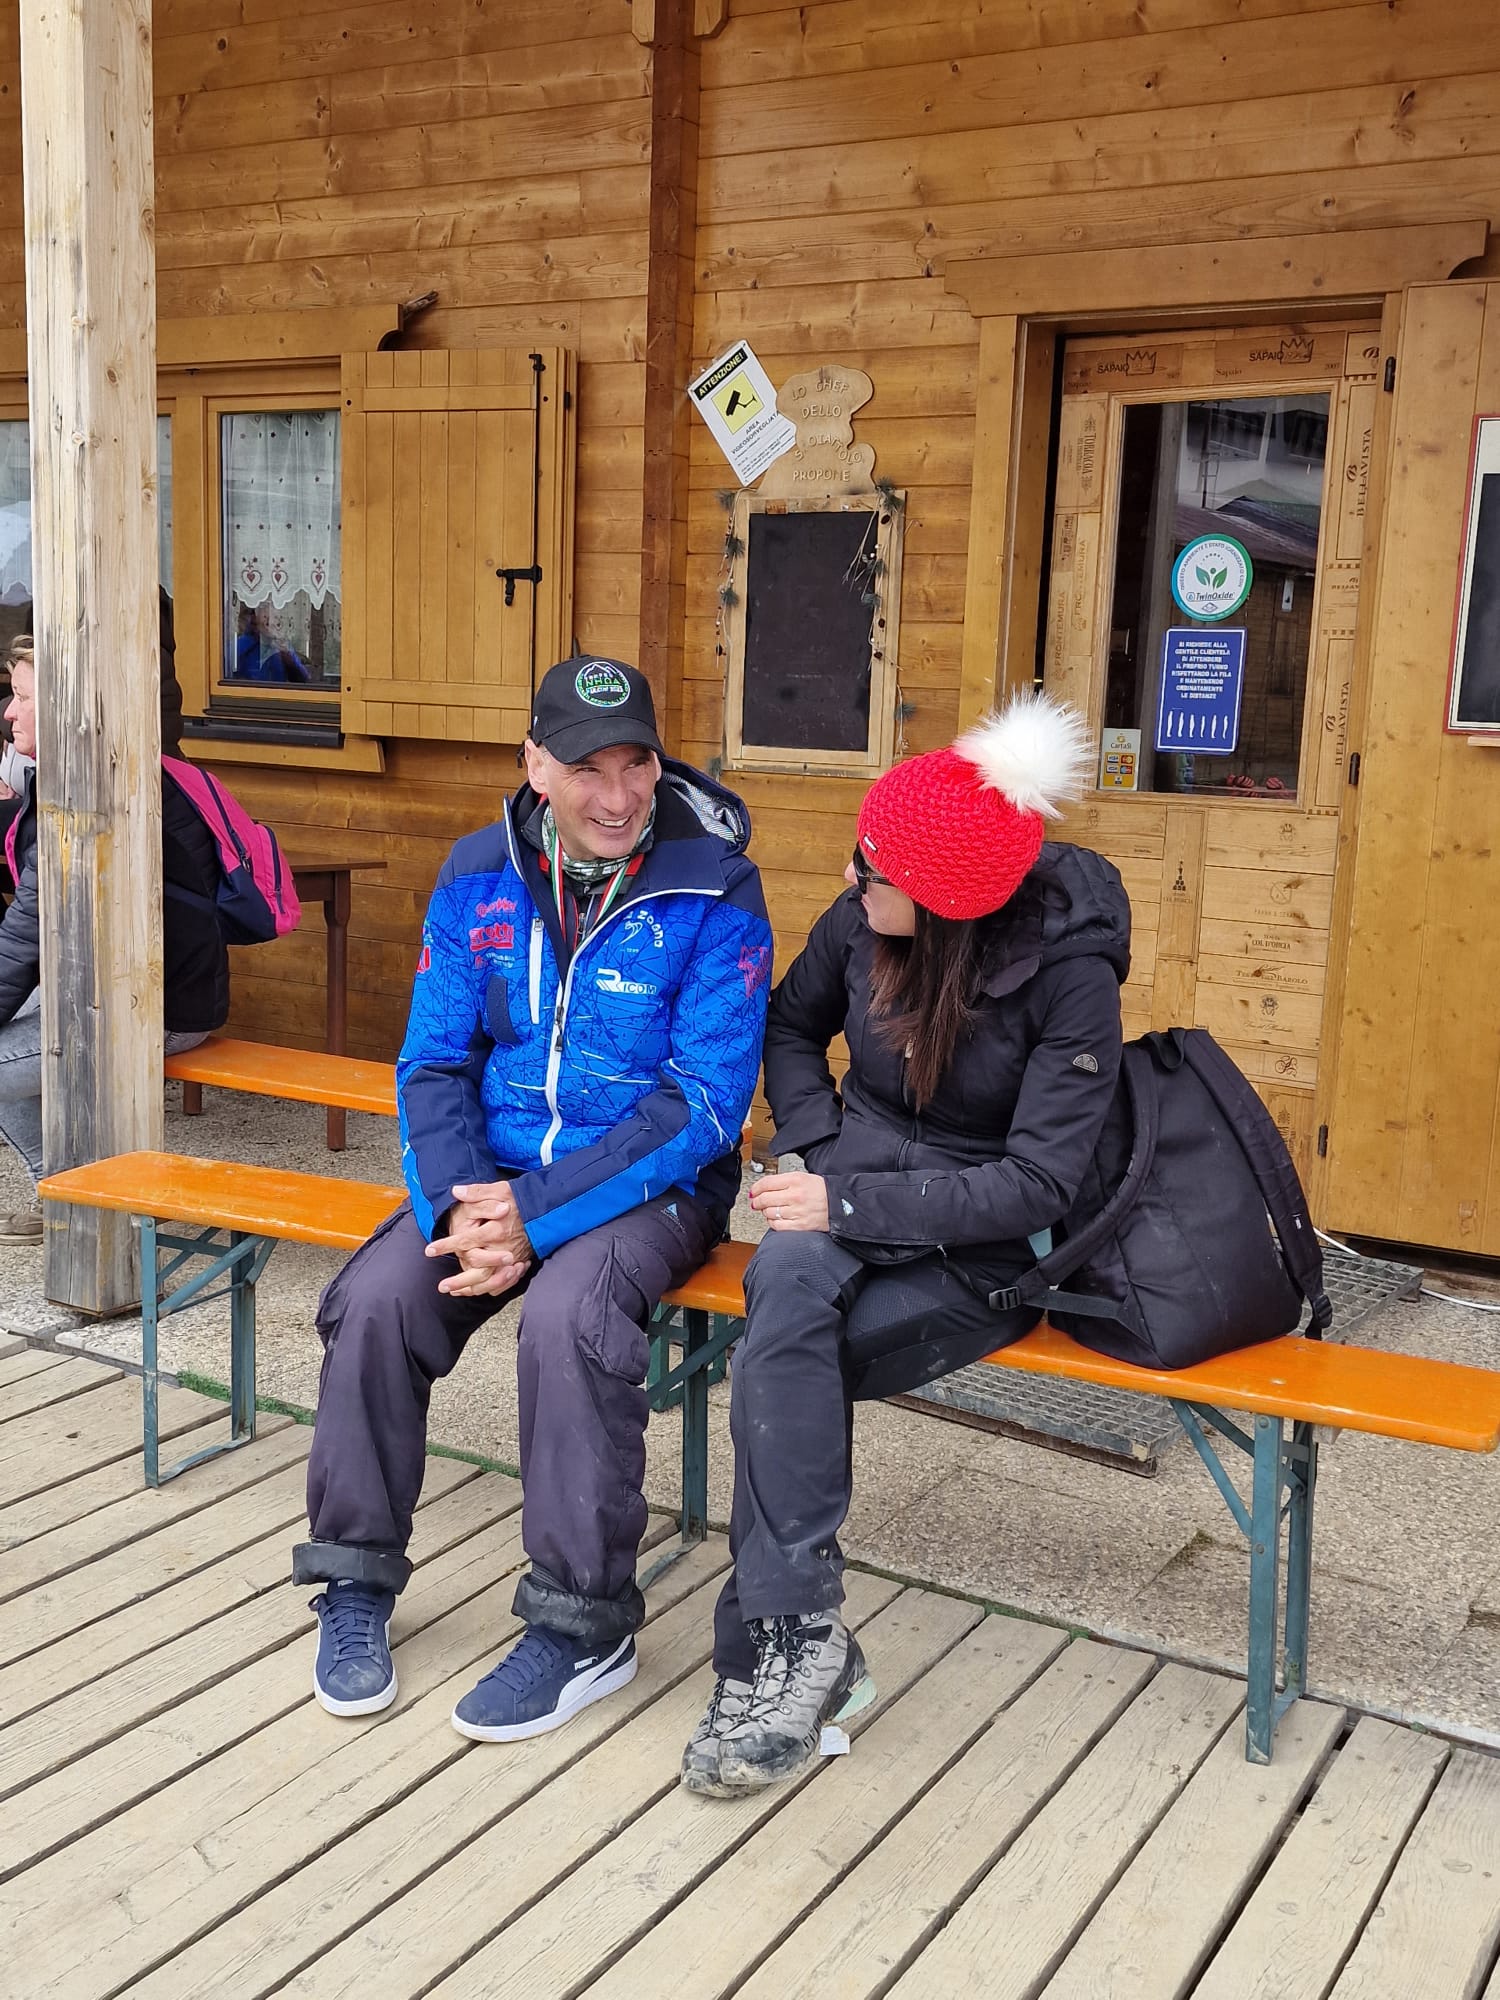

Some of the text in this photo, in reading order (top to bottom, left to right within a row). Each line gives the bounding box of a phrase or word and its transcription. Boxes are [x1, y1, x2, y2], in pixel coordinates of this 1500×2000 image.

[1249, 351, 1284, 362] SAPAIO
[698, 352, 744, 396] ATTENZIONE!
[792, 378, 850, 401] LO CHEF
[802, 404, 842, 419] DELLO
[745, 421, 761, 435] AREA
[1356, 428, 1371, 516] BELLAVISTA
[1196, 592, 1234, 600] TwinOxide
[1055, 591, 1066, 667] FRONTEMURA
[1335, 682, 1350, 766] BELLAVISTA
[637, 910, 664, 948] ZOGNO
[1277, 975, 1309, 985] BAROLO
